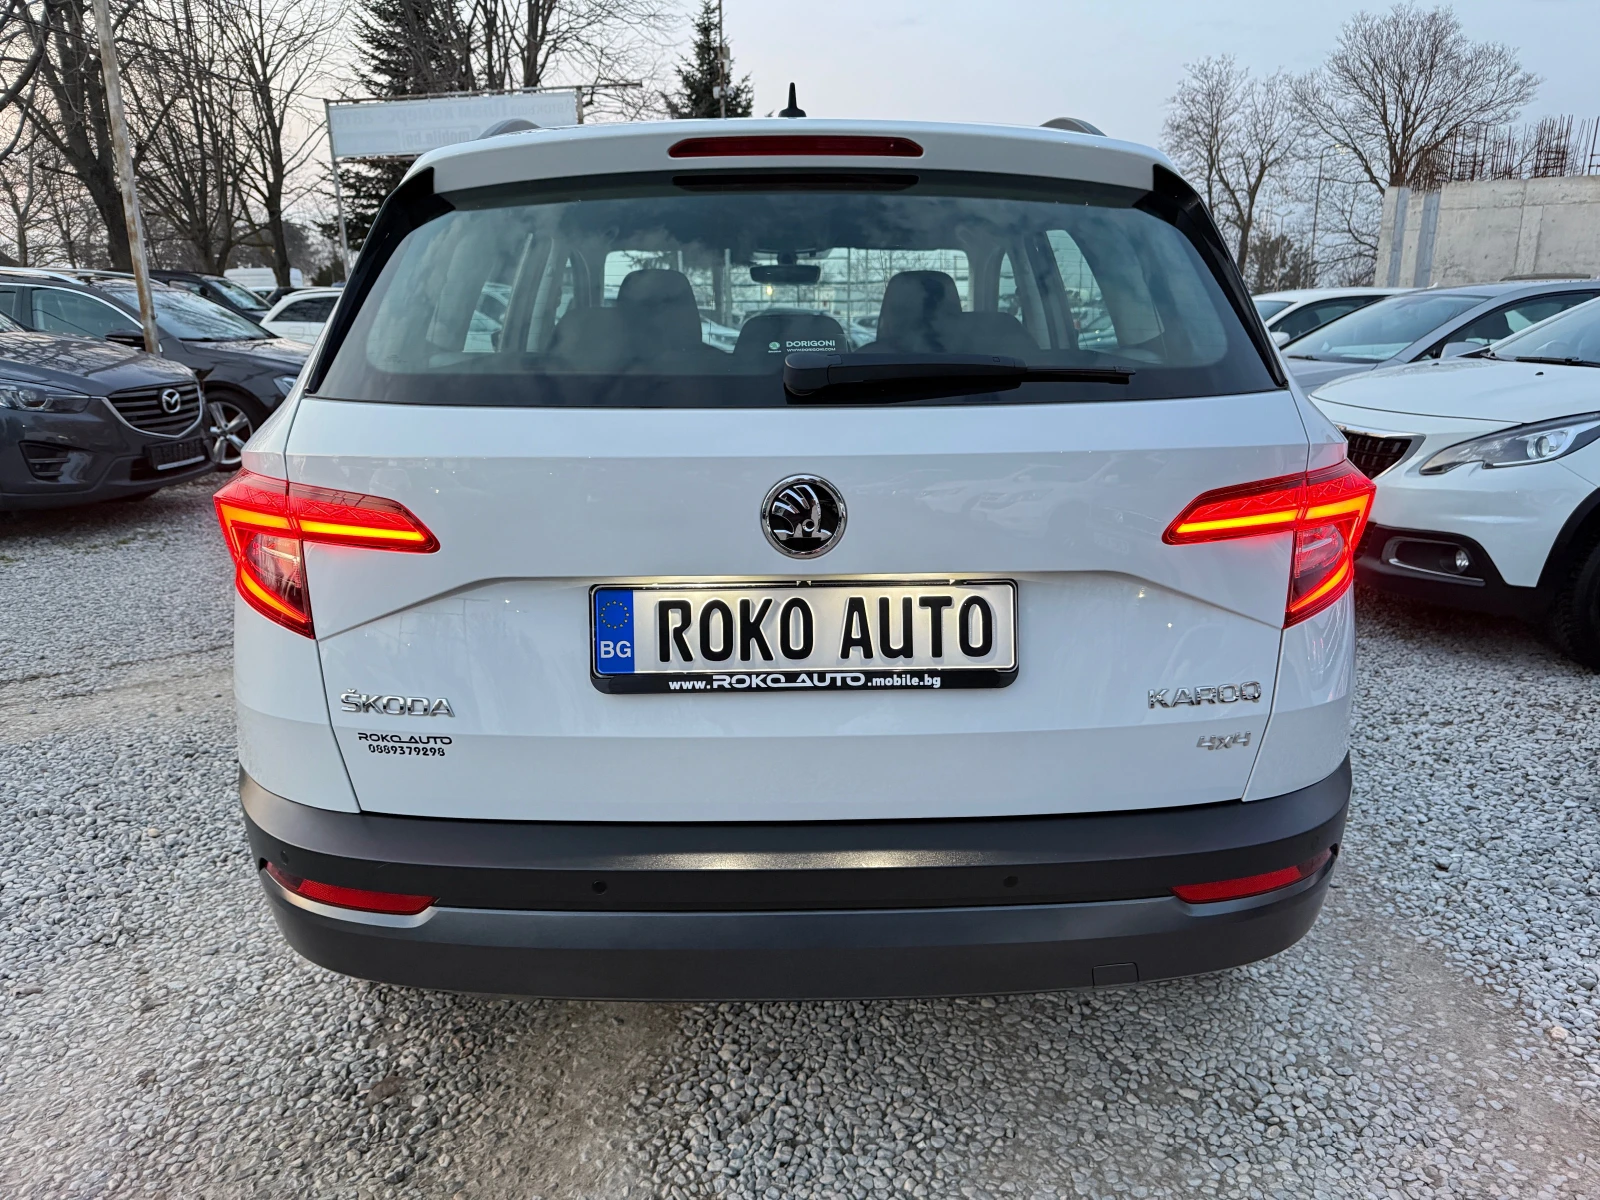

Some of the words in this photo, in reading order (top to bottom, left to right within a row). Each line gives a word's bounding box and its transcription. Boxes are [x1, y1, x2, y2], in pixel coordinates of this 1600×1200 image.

[786, 340, 836, 348] DORIGONI
[658, 597, 814, 663] ROKO
[840, 595, 993, 660] AUTO
[600, 641, 631, 659] BG
[340, 688, 455, 717] ŠKODA
[1148, 681, 1261, 709] KAROQ
[358, 732, 402, 744] ROKO
[408, 735, 452, 745] AUTO
[368, 743, 445, 757] 0889379298
